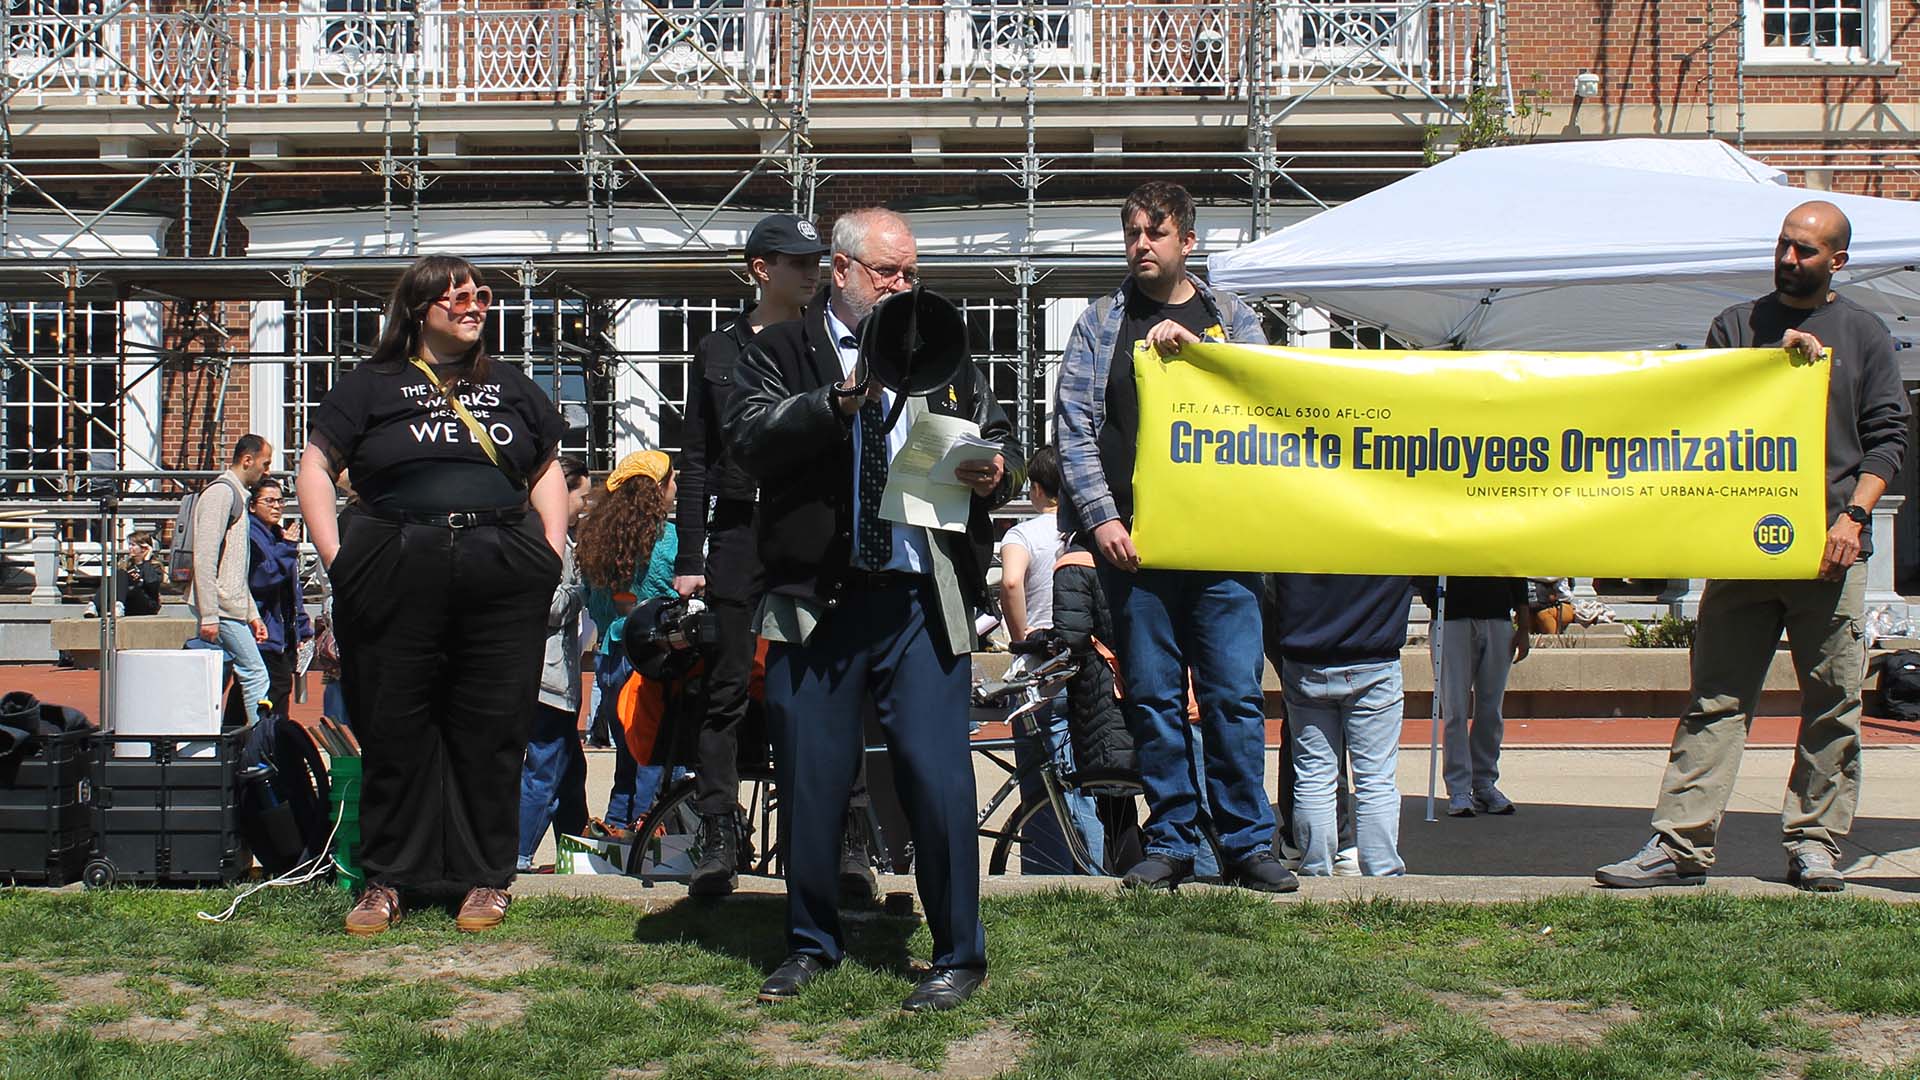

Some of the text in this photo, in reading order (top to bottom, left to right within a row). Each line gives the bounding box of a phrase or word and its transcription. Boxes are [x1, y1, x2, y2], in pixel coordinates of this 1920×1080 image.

[400, 384, 427, 398] THE
[1172, 403, 1392, 419] I.F.T. / A.F.T. LOCAL 6300 AFL-CIO
[410, 422, 459, 443] WE
[1170, 420, 1798, 479] Graduate Employees Organization
[1466, 486, 1799, 497] UNIVERSITY OF ILLINOIS AT URBANA-CHAMPAIGN
[1758, 525, 1789, 544] GEO
